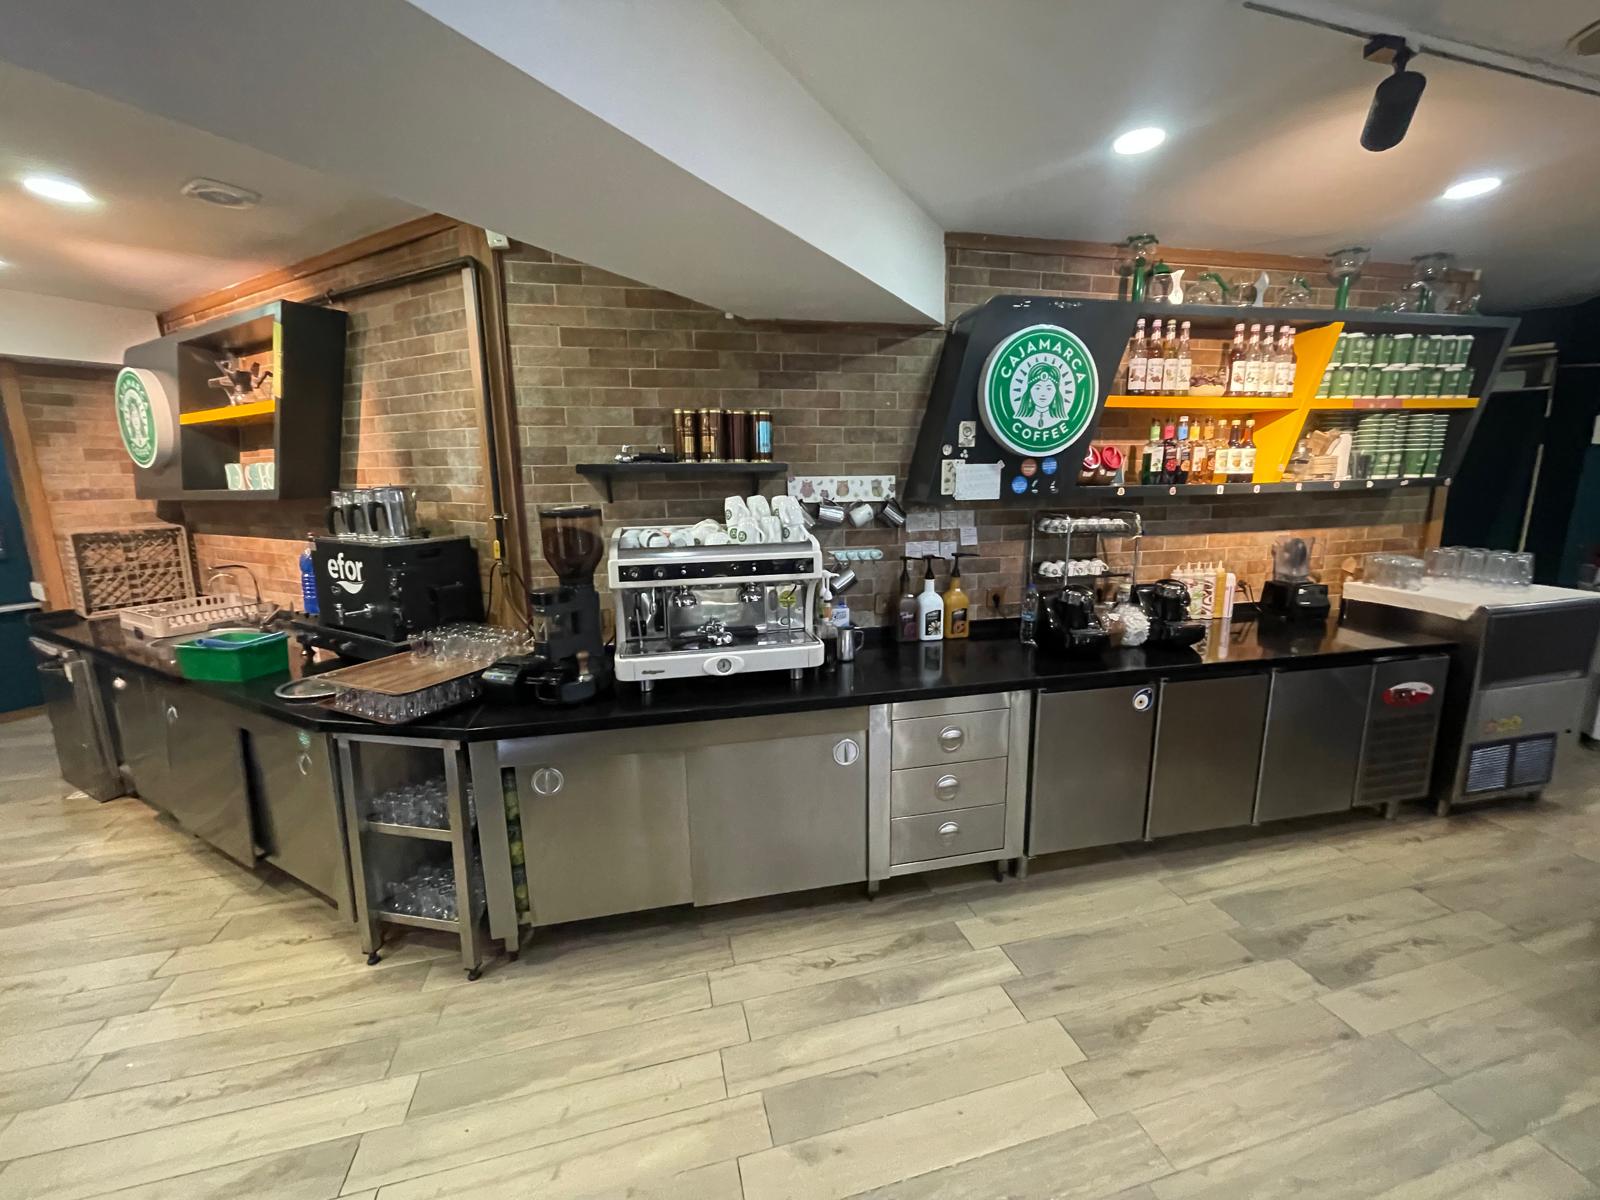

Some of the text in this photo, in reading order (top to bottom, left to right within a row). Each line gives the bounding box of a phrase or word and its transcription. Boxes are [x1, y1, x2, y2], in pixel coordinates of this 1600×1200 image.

[1001, 338, 1087, 384] CAJAMARCA
[1012, 422, 1069, 442] COFFEE
[327, 552, 363, 582] efor
